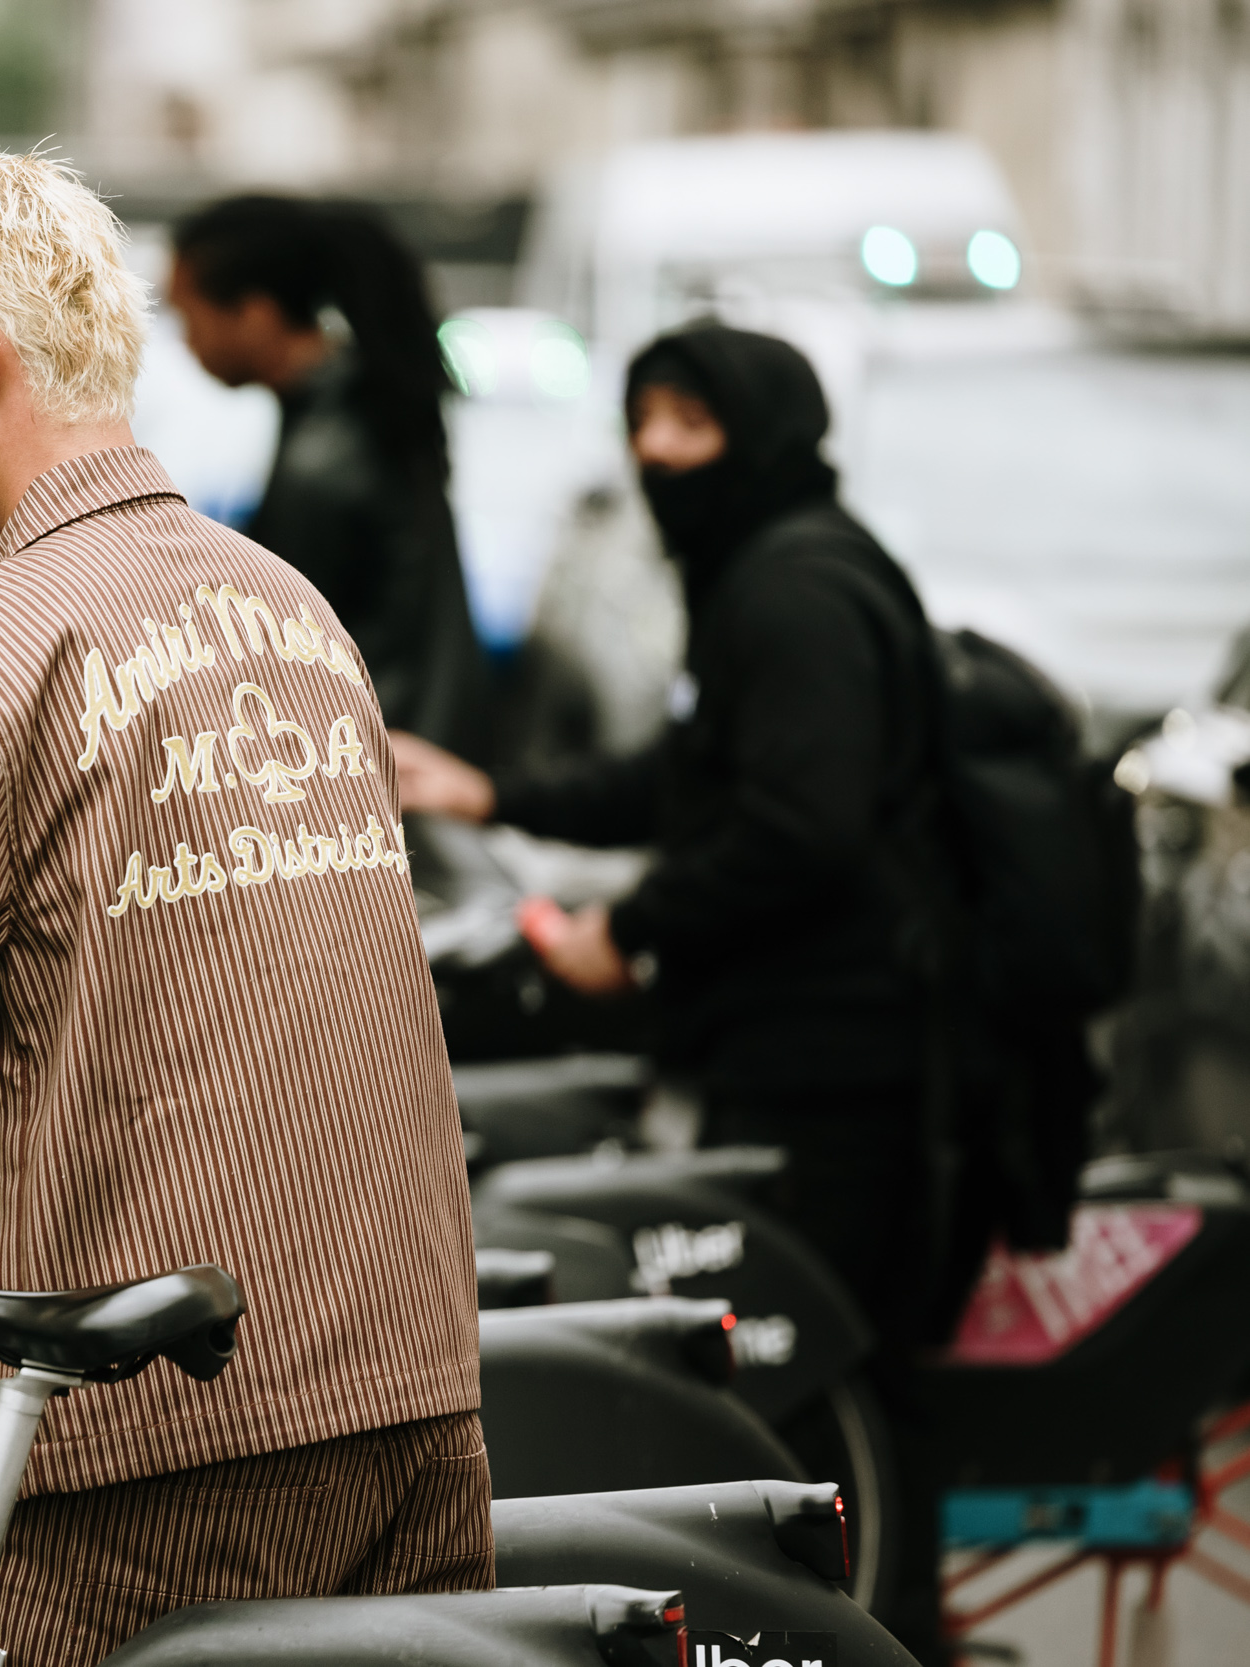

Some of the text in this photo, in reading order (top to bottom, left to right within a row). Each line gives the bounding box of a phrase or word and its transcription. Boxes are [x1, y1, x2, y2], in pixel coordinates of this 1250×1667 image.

[78, 602, 215, 770] Amiri
[108, 843, 227, 917] Arts
[229, 814, 405, 887] District,
